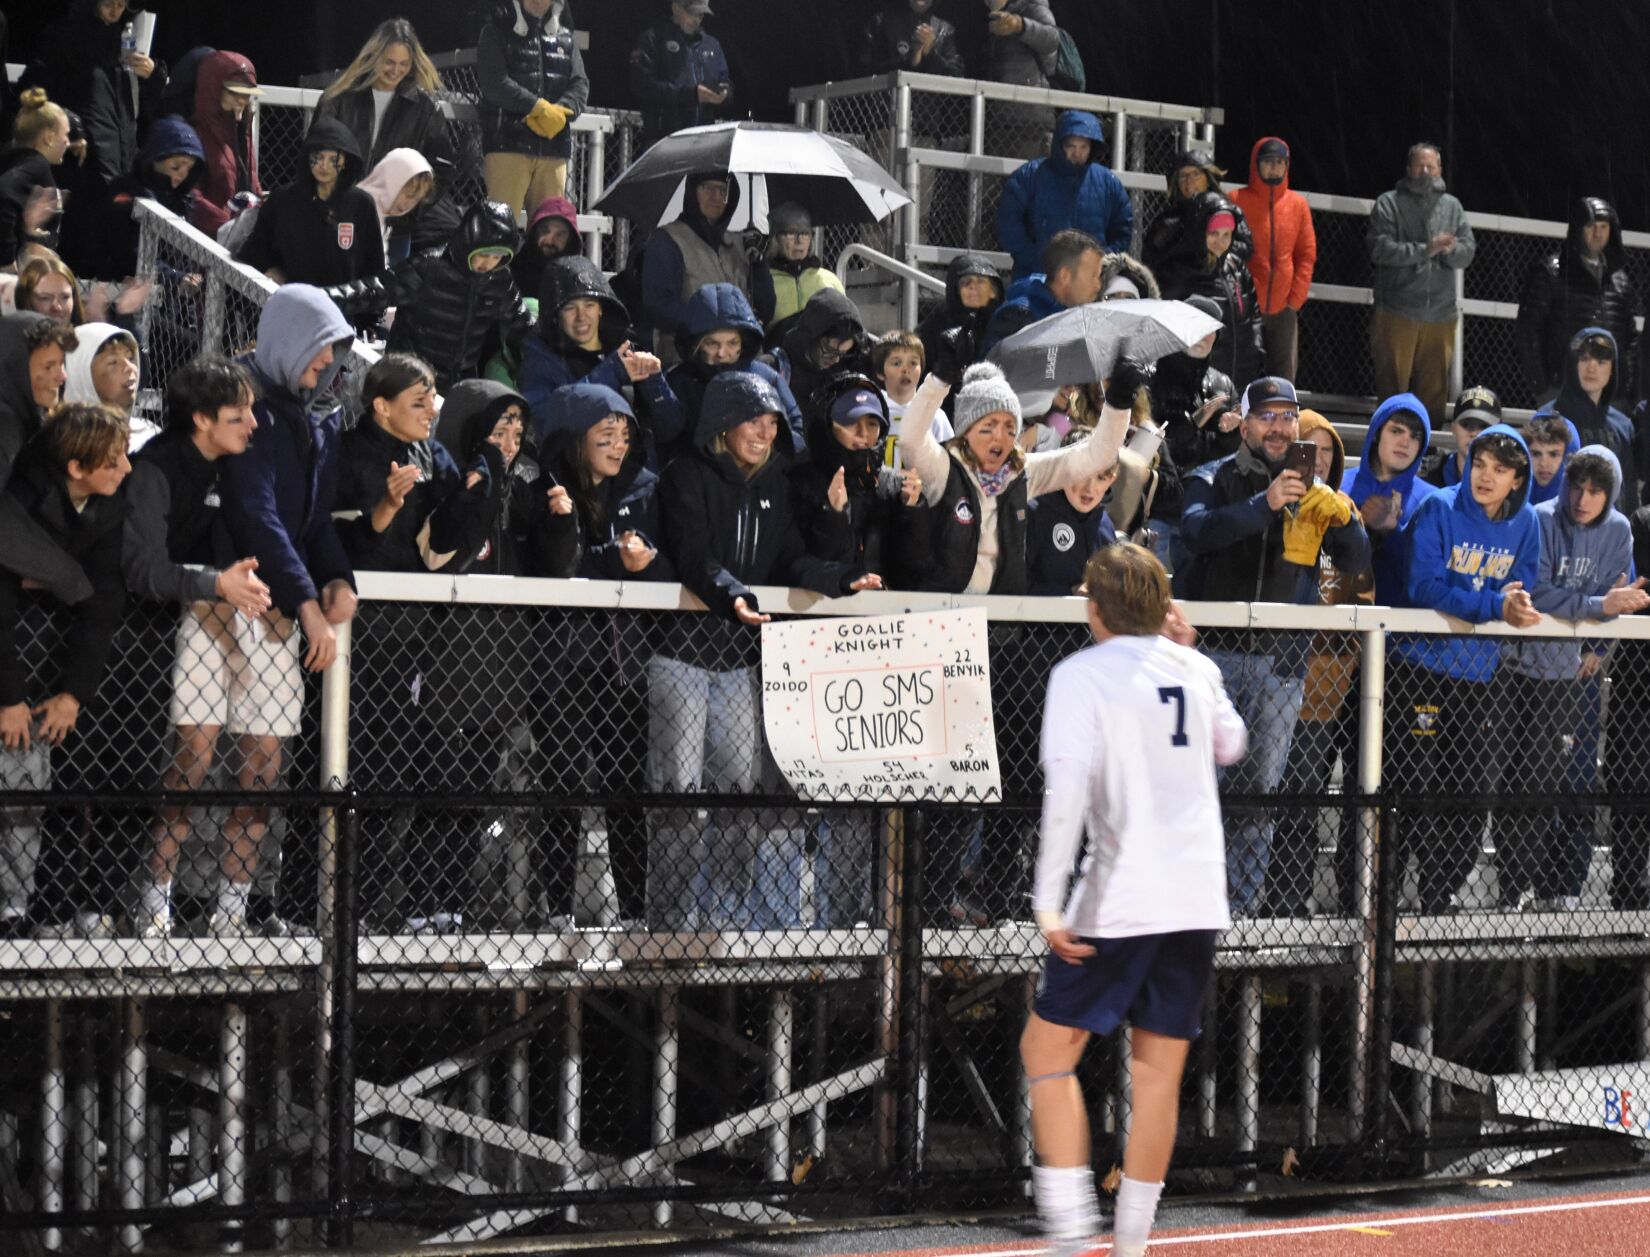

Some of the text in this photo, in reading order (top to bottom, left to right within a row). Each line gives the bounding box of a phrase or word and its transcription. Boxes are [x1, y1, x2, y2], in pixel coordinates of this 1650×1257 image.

[838, 620, 905, 637] GOALIE
[834, 638, 904, 653] KNIGHT
[955, 649, 972, 663] 22
[782, 662, 791, 677] 9
[943, 664, 986, 678] BENYIK
[824, 670, 934, 714] GO SMS
[1158, 686, 1188, 746] 7
[835, 710, 924, 752] SENIORS
[965, 744, 974, 758] 5
[793, 760, 806, 769] 17
[883, 761, 902, 773] 54
[950, 760, 990, 772] BARON
[784, 769, 825, 779] VITAS
[863, 772, 928, 783] HOLSCHER
